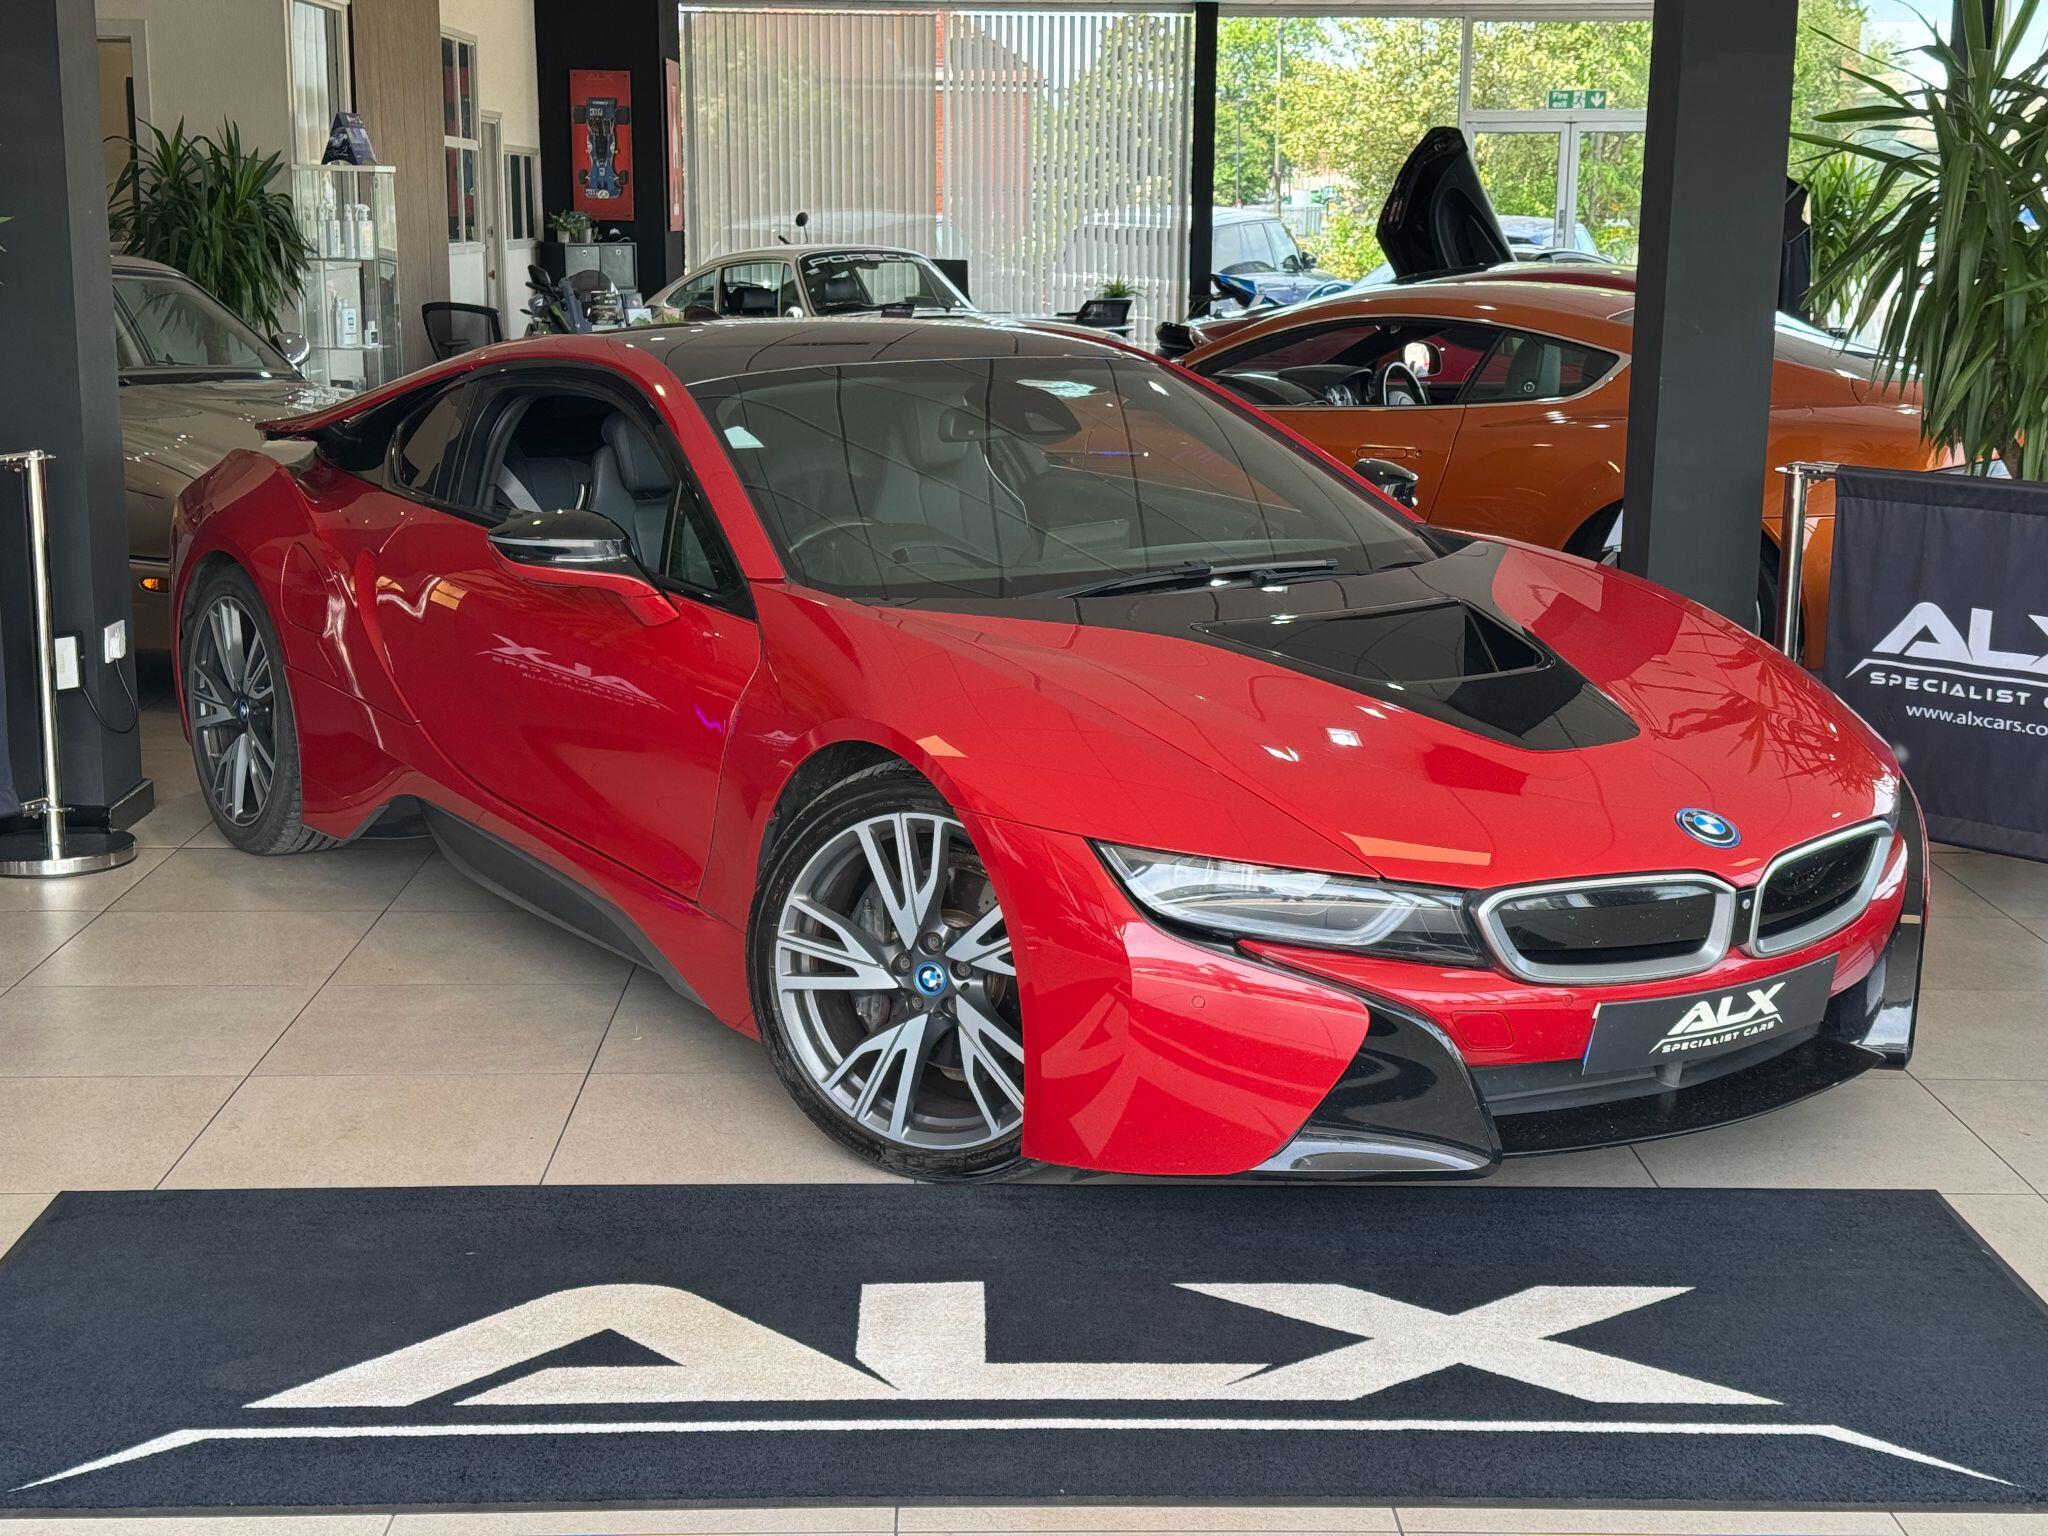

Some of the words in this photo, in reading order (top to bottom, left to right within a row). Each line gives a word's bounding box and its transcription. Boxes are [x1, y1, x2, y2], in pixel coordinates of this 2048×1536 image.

[1552, 91, 1569, 100] Fire
[1552, 100, 1568, 108] exit
[1871, 602, 2048, 676] AL
[1869, 672, 2032, 706] SPECIALIST
[1905, 704, 2048, 737] www.alxcars.co
[1667, 981, 1786, 1035] ALX
[1661, 1031, 1740, 1054] SPECIALIST
[1743, 1020, 1775, 1037] CARS
[240, 1282, 1785, 1409] ALX
